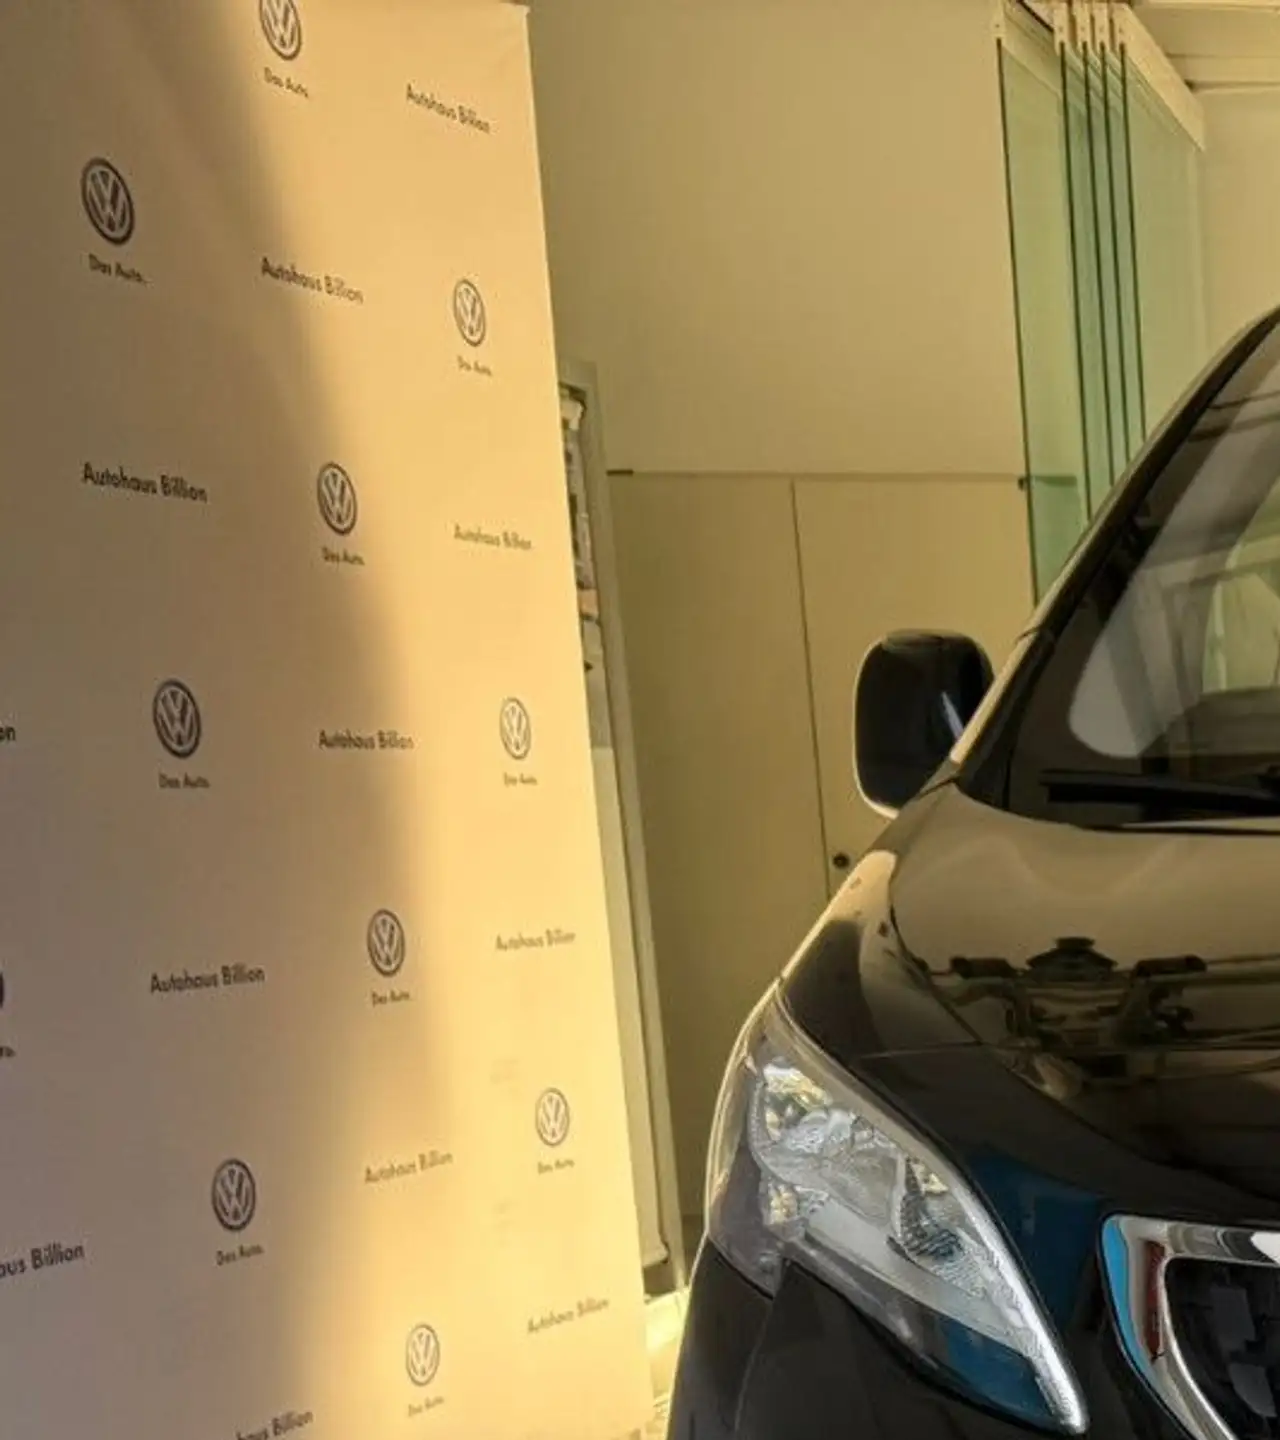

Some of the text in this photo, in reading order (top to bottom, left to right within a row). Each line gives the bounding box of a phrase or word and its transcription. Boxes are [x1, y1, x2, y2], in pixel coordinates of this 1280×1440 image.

[261, 256, 364, 305] Autohaus Billion
[82, 461, 208, 504] Autohaus Billion
[318, 728, 415, 750] Autohaus Billion
[150, 963, 266, 994] Autohaus Billion
[30, 1242, 85, 1271] Billion
[271, 1411, 314, 1437] Billion
